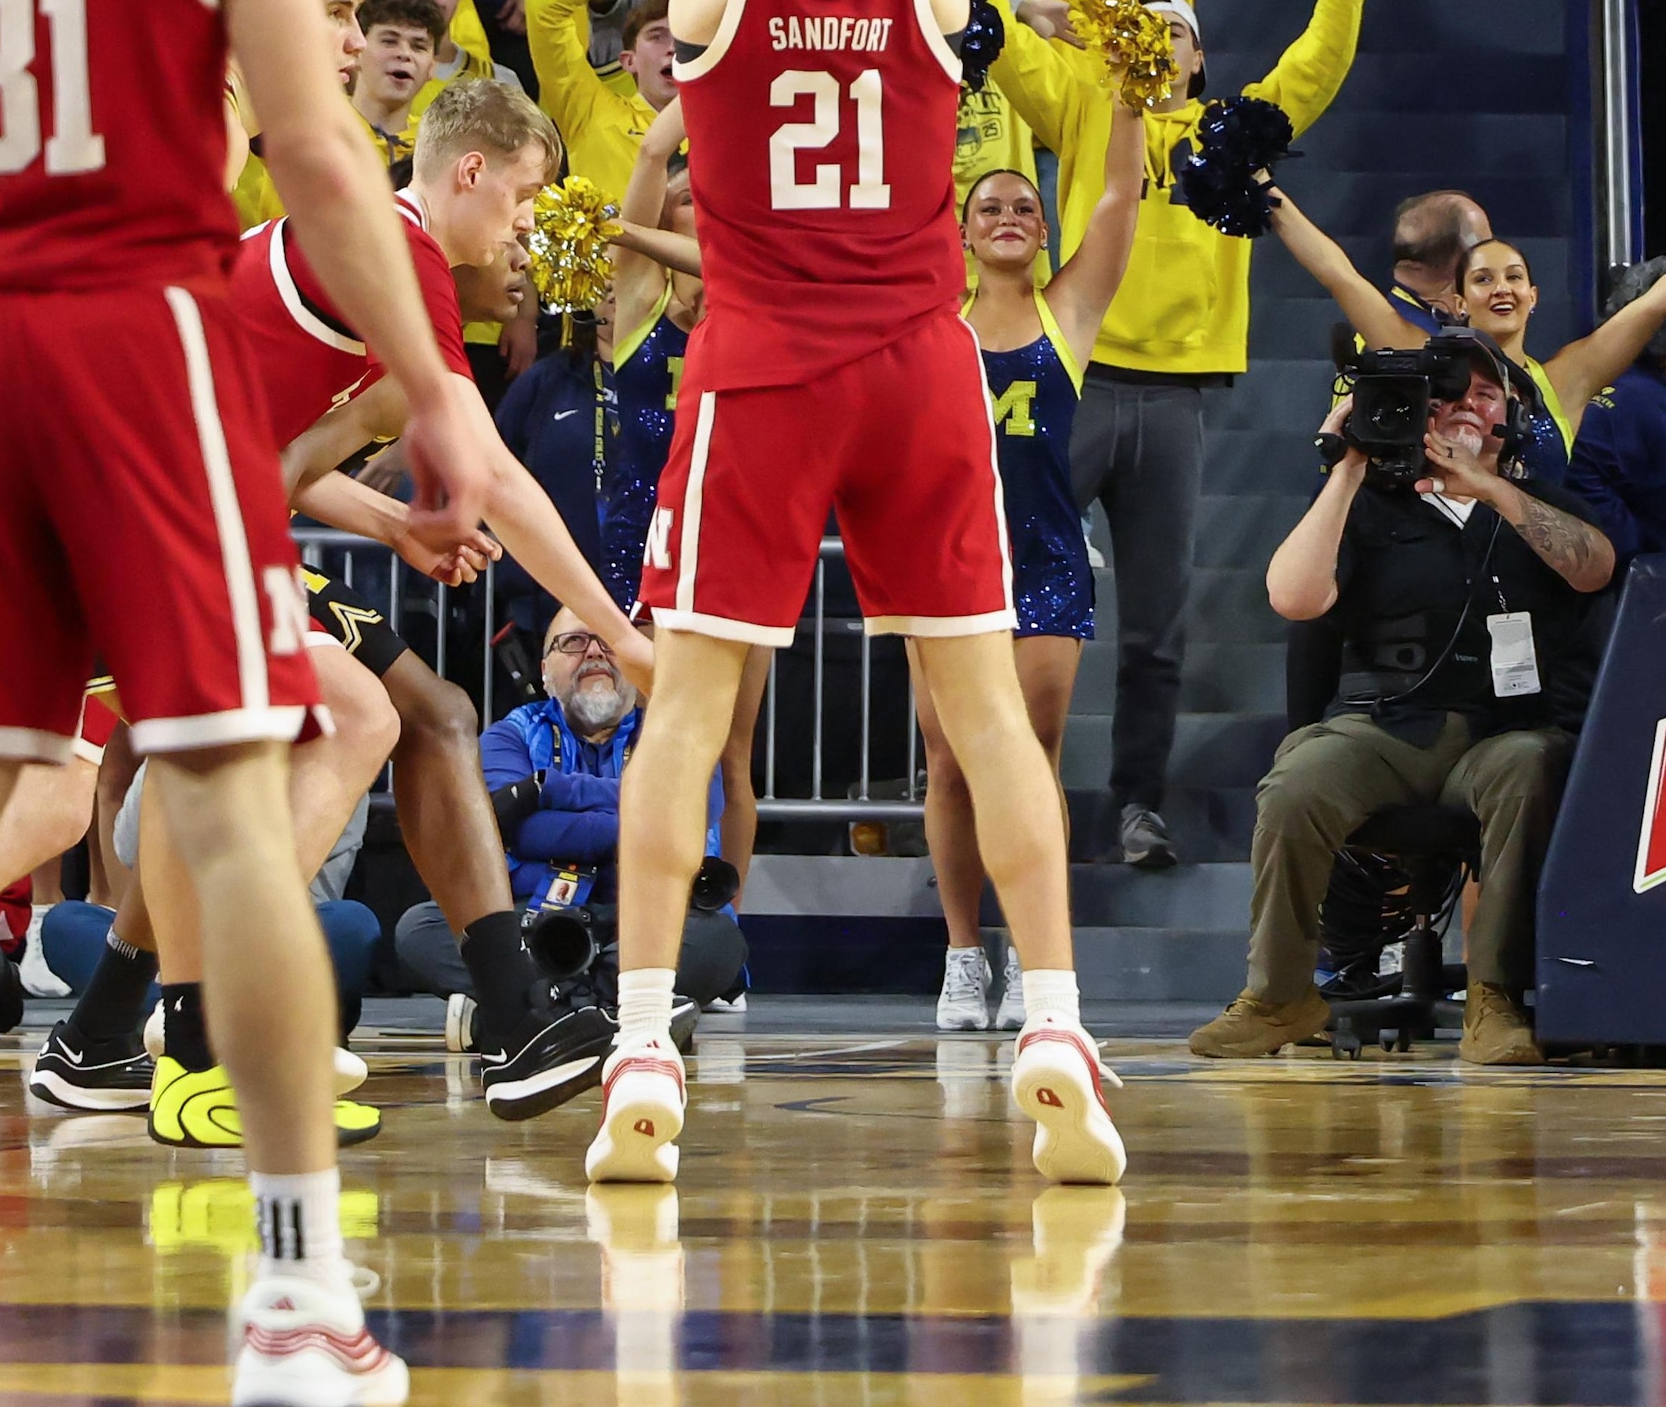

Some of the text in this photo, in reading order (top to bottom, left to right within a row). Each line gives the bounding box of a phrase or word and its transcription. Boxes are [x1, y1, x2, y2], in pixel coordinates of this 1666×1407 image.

[768, 16, 893, 53] SANDFORT
[769, 68, 893, 210] 21
[988, 379, 1037, 437] M
[642, 504, 674, 571] N
[261, 561, 310, 657] N
